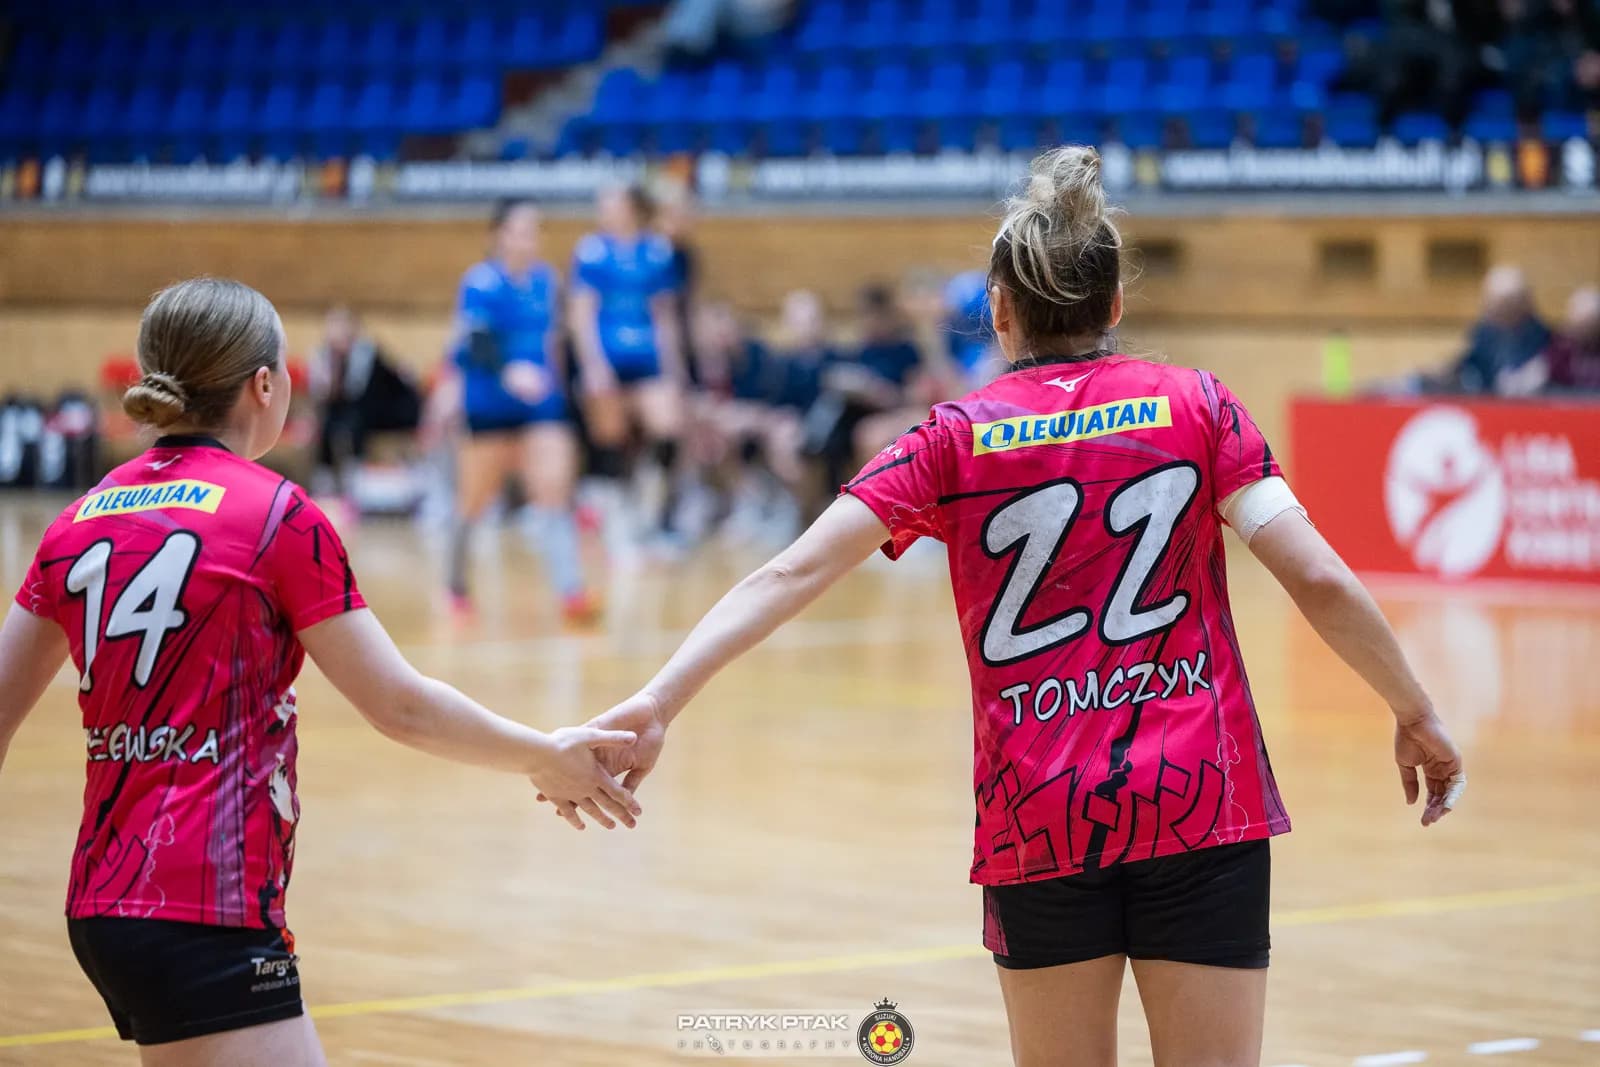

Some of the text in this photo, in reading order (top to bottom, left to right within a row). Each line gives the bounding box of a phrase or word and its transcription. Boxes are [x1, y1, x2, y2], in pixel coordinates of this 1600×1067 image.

[1018, 402, 1158, 443] LEWIATAN
[102, 484, 211, 511] LEWIATAN
[980, 460, 1201, 667] 22
[65, 529, 202, 692] 14
[1000, 651, 1211, 726] TOMCZYK
